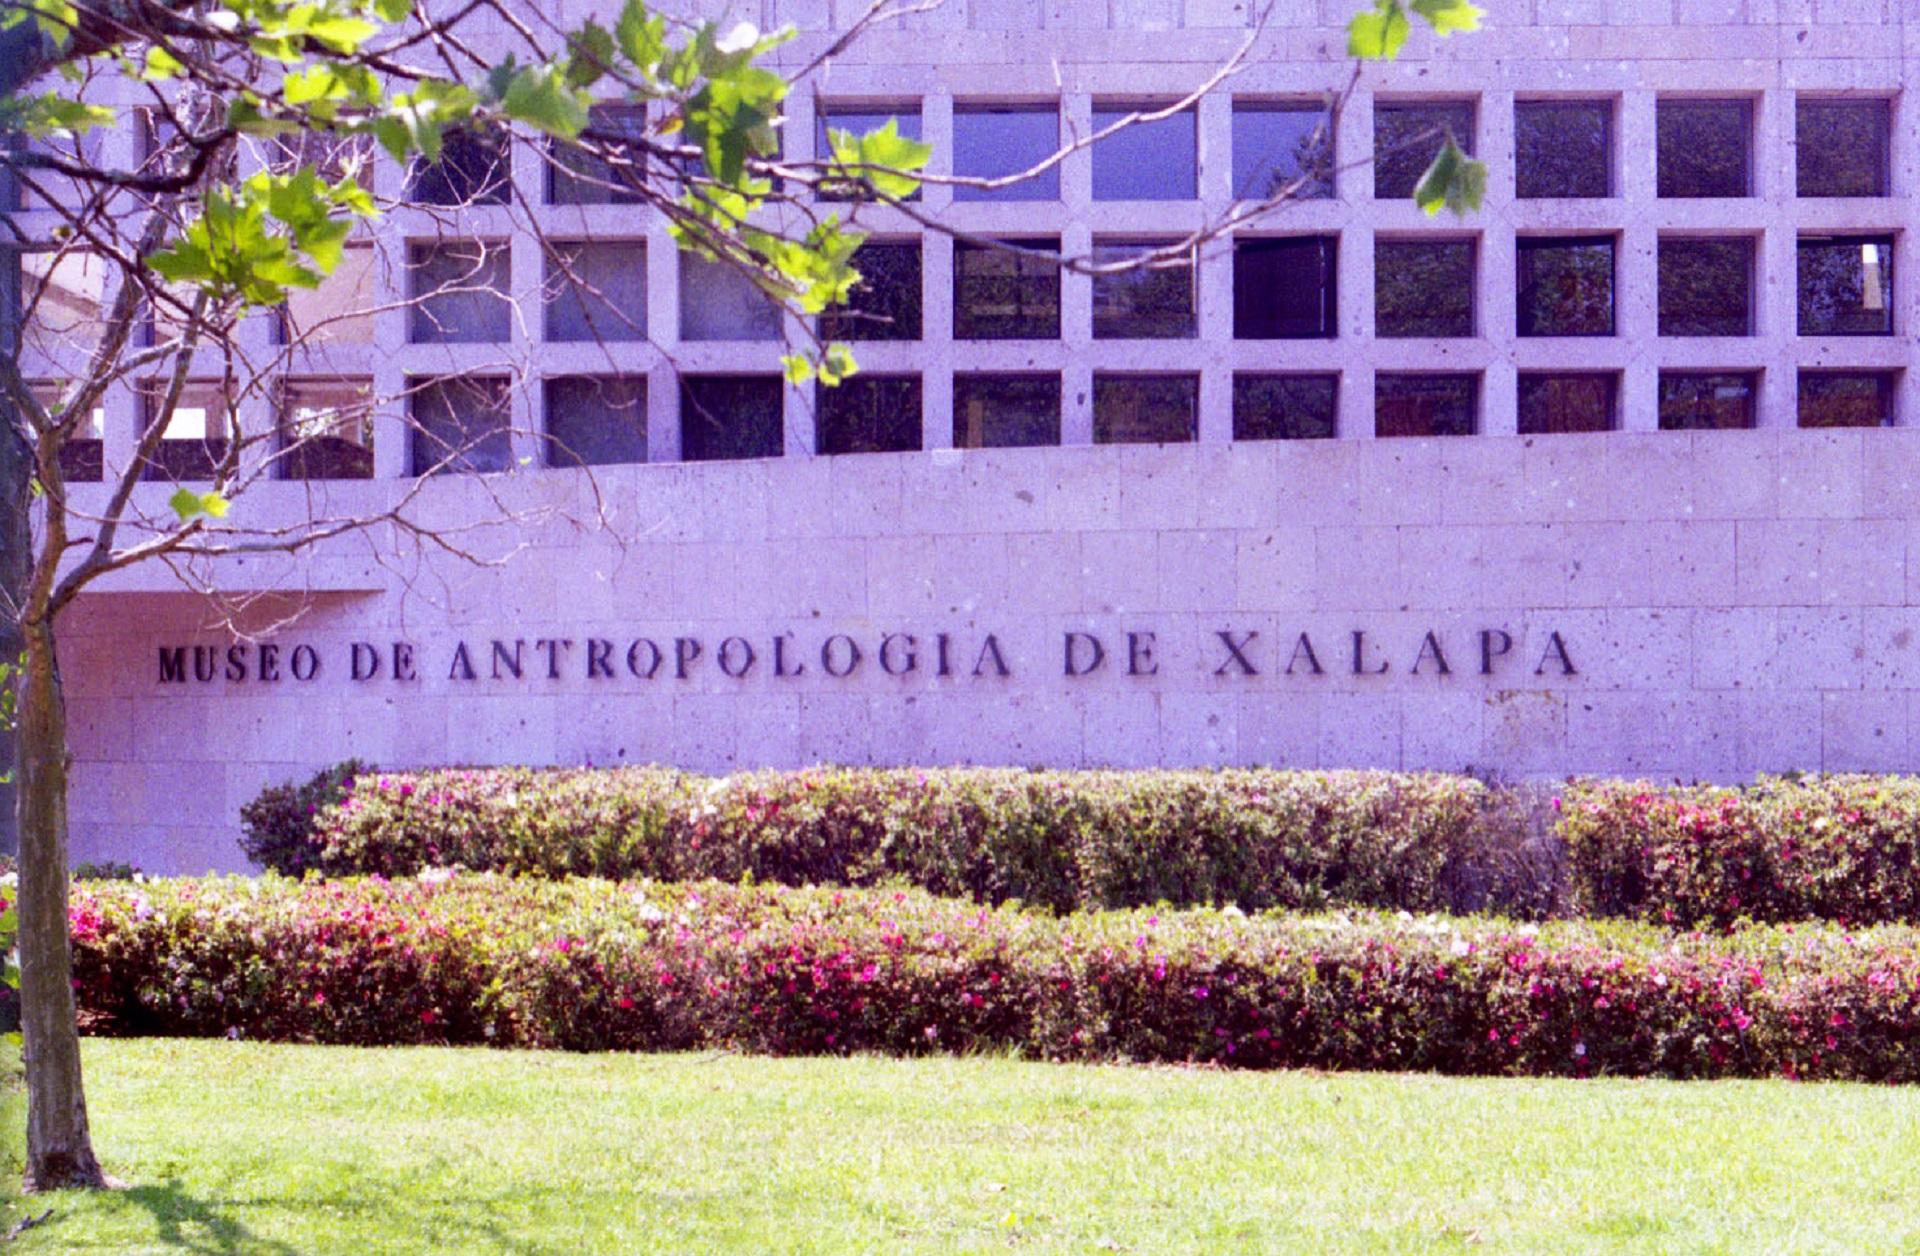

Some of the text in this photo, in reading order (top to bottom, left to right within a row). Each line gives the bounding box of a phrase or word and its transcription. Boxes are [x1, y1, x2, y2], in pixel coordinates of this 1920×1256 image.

[159, 630, 1577, 682] MUSEO DE ANTROPOLOGIA DE XALAPA
